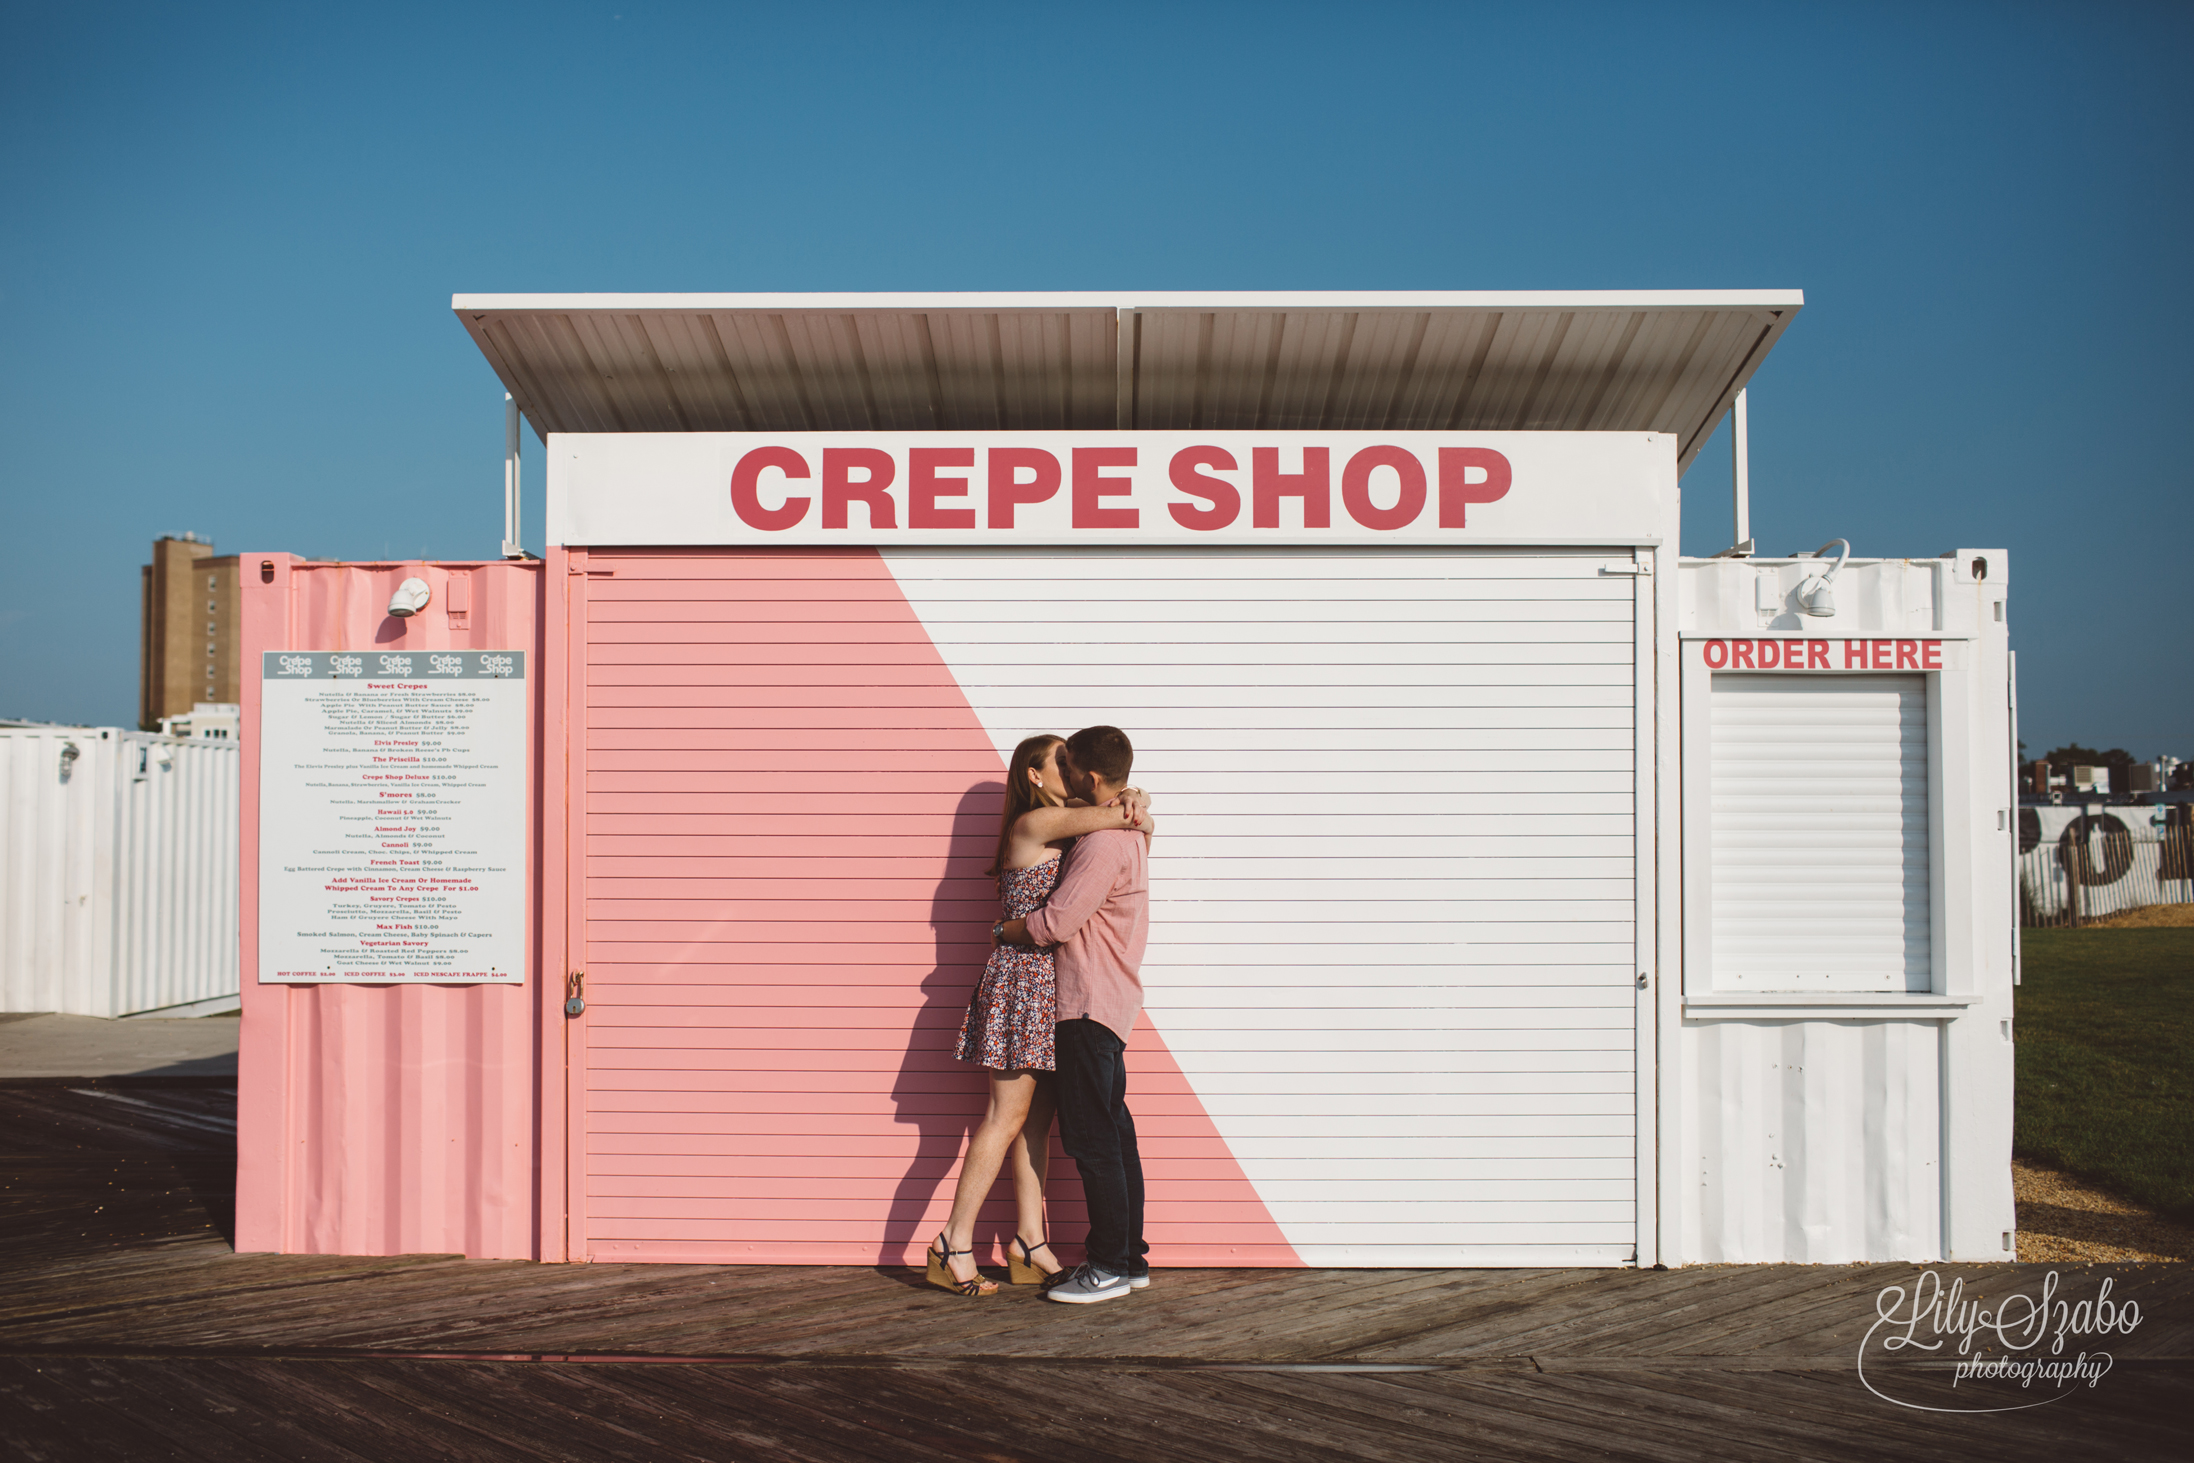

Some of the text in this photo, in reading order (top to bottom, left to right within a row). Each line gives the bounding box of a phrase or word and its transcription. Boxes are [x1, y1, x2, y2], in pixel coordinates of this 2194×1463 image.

[731, 445, 1513, 531] CREPE SHOP
[1703, 639, 1942, 669] ORDER HERE
[277, 664, 312, 678] Shop
[328, 664, 363, 678] Shop
[377, 664, 413, 678] Shop
[427, 664, 463, 678] Shop
[478, 664, 513, 677] Shop
